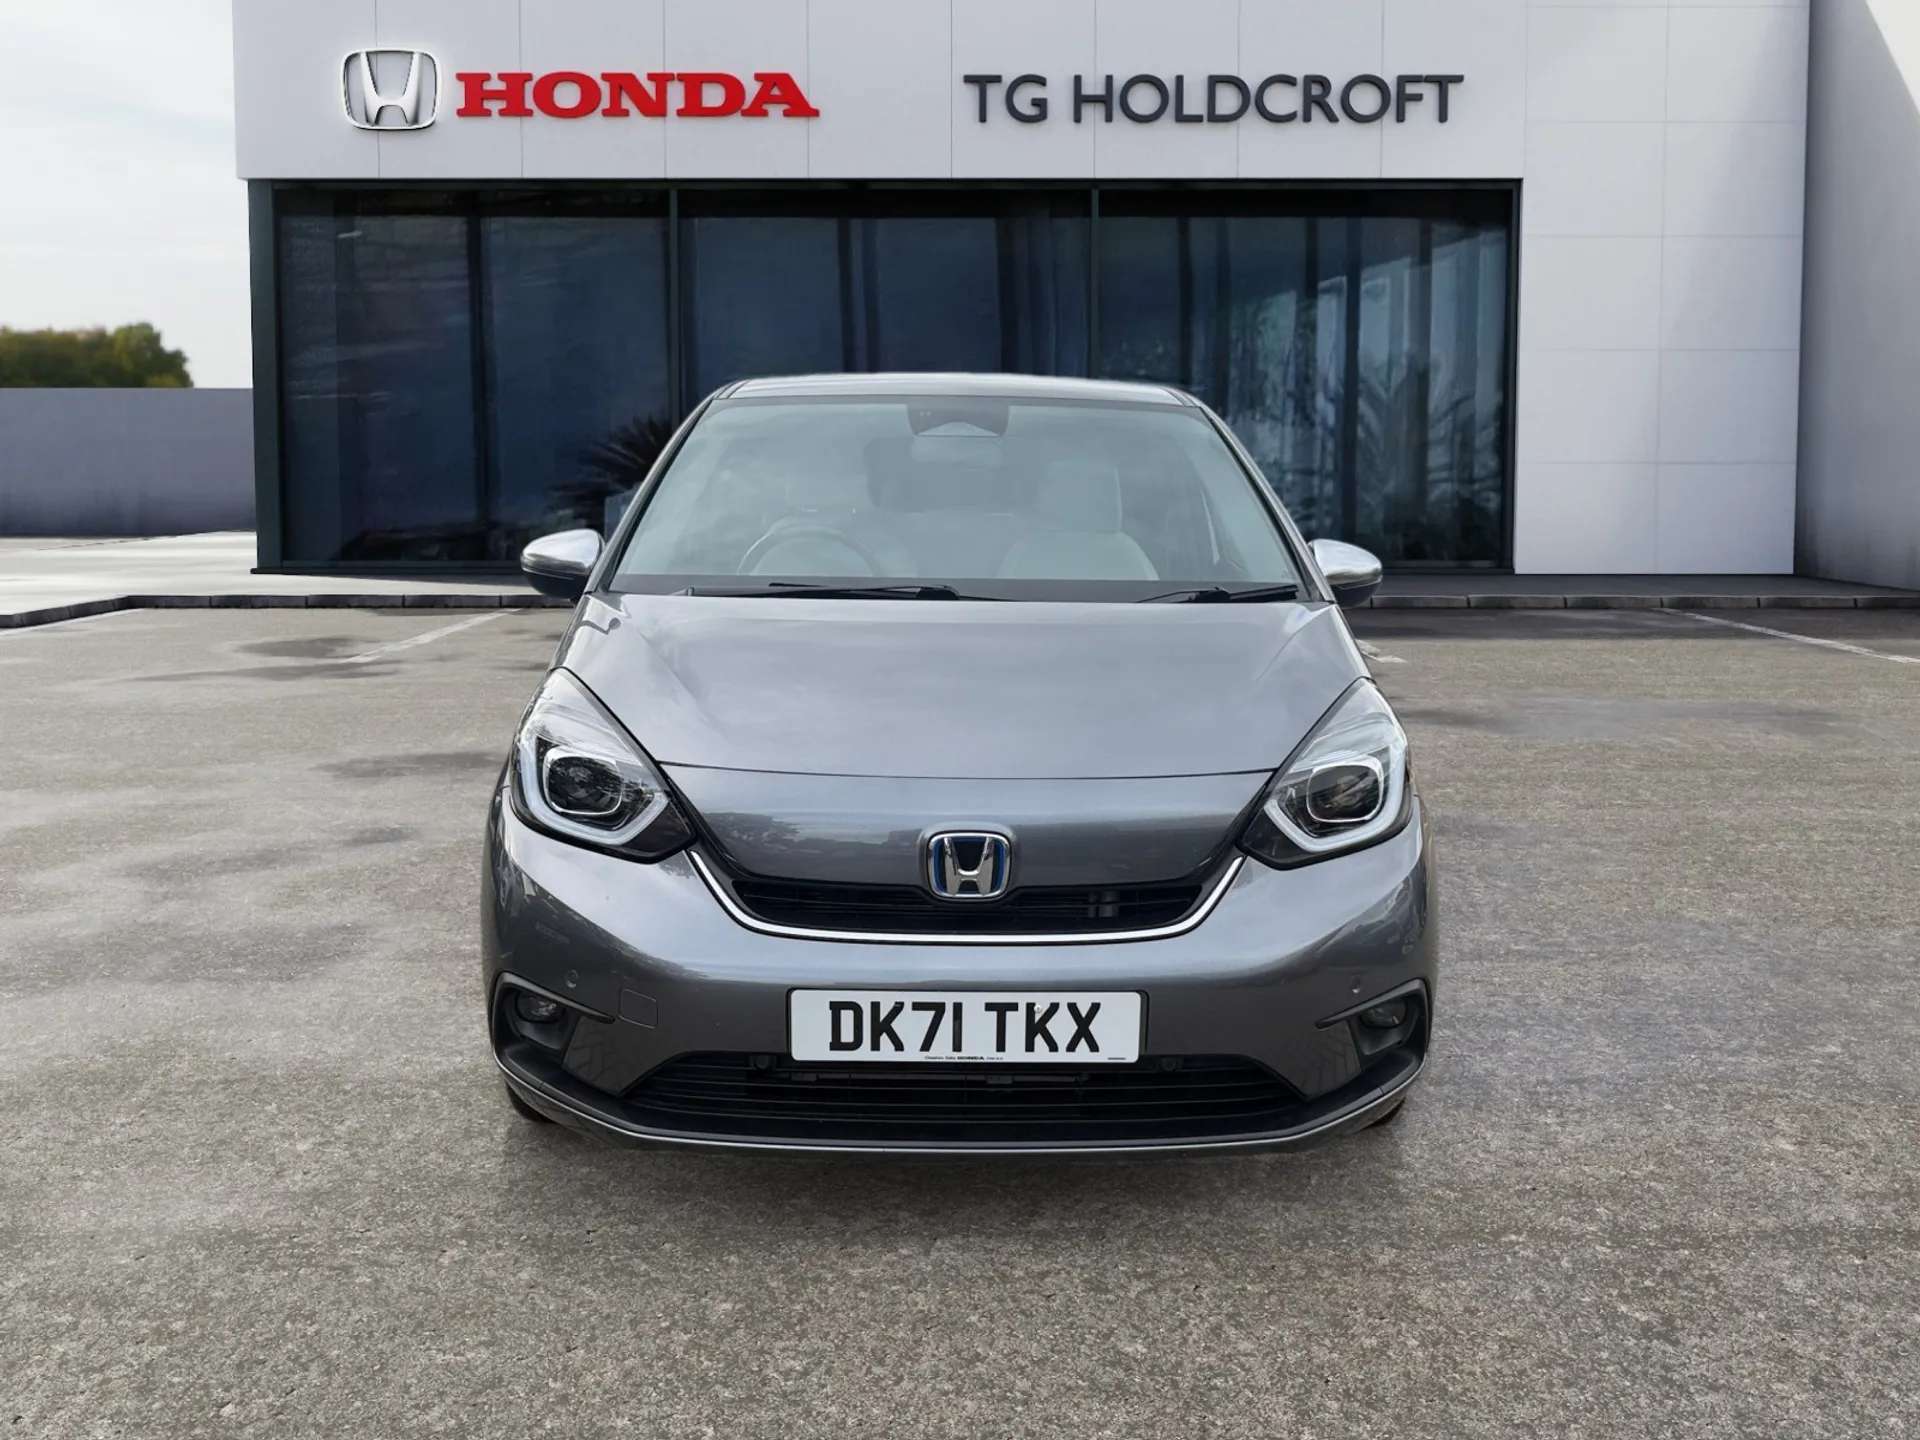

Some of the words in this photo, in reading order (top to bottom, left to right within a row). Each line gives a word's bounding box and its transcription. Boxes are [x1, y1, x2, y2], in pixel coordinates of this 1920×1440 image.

[455, 71, 820, 119] HONDA
[963, 74, 1048, 123] TG
[1073, 74, 1464, 123] HOLDCROFT
[829, 1001, 963, 1053] DK71
[984, 1002, 1101, 1053] TKX
